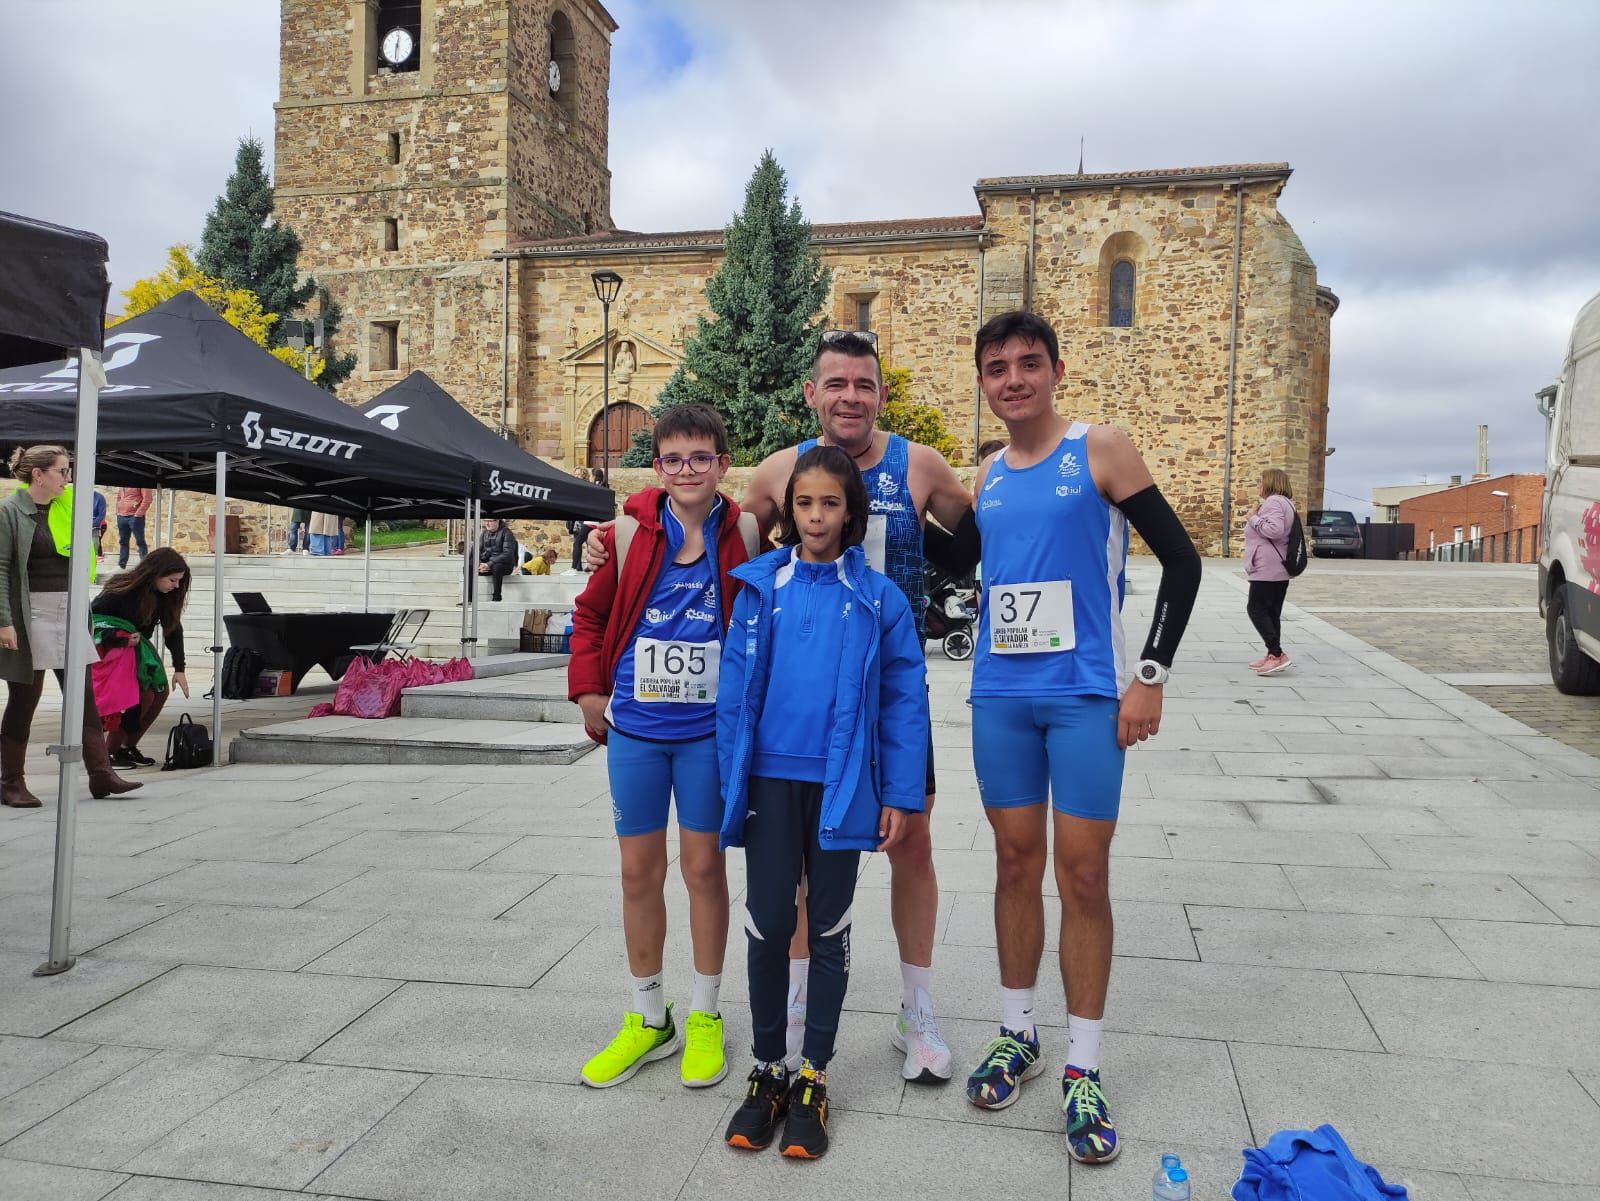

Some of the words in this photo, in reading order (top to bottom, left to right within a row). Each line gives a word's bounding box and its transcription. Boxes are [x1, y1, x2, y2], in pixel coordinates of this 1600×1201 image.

[265, 428, 362, 459] SCOTT
[501, 480, 552, 500] SCOTT
[1000, 591, 1041, 623] 37
[644, 644, 706, 675] 165
[640, 683, 646, 692] EL
[648, 684, 680, 694] SALVADOR
